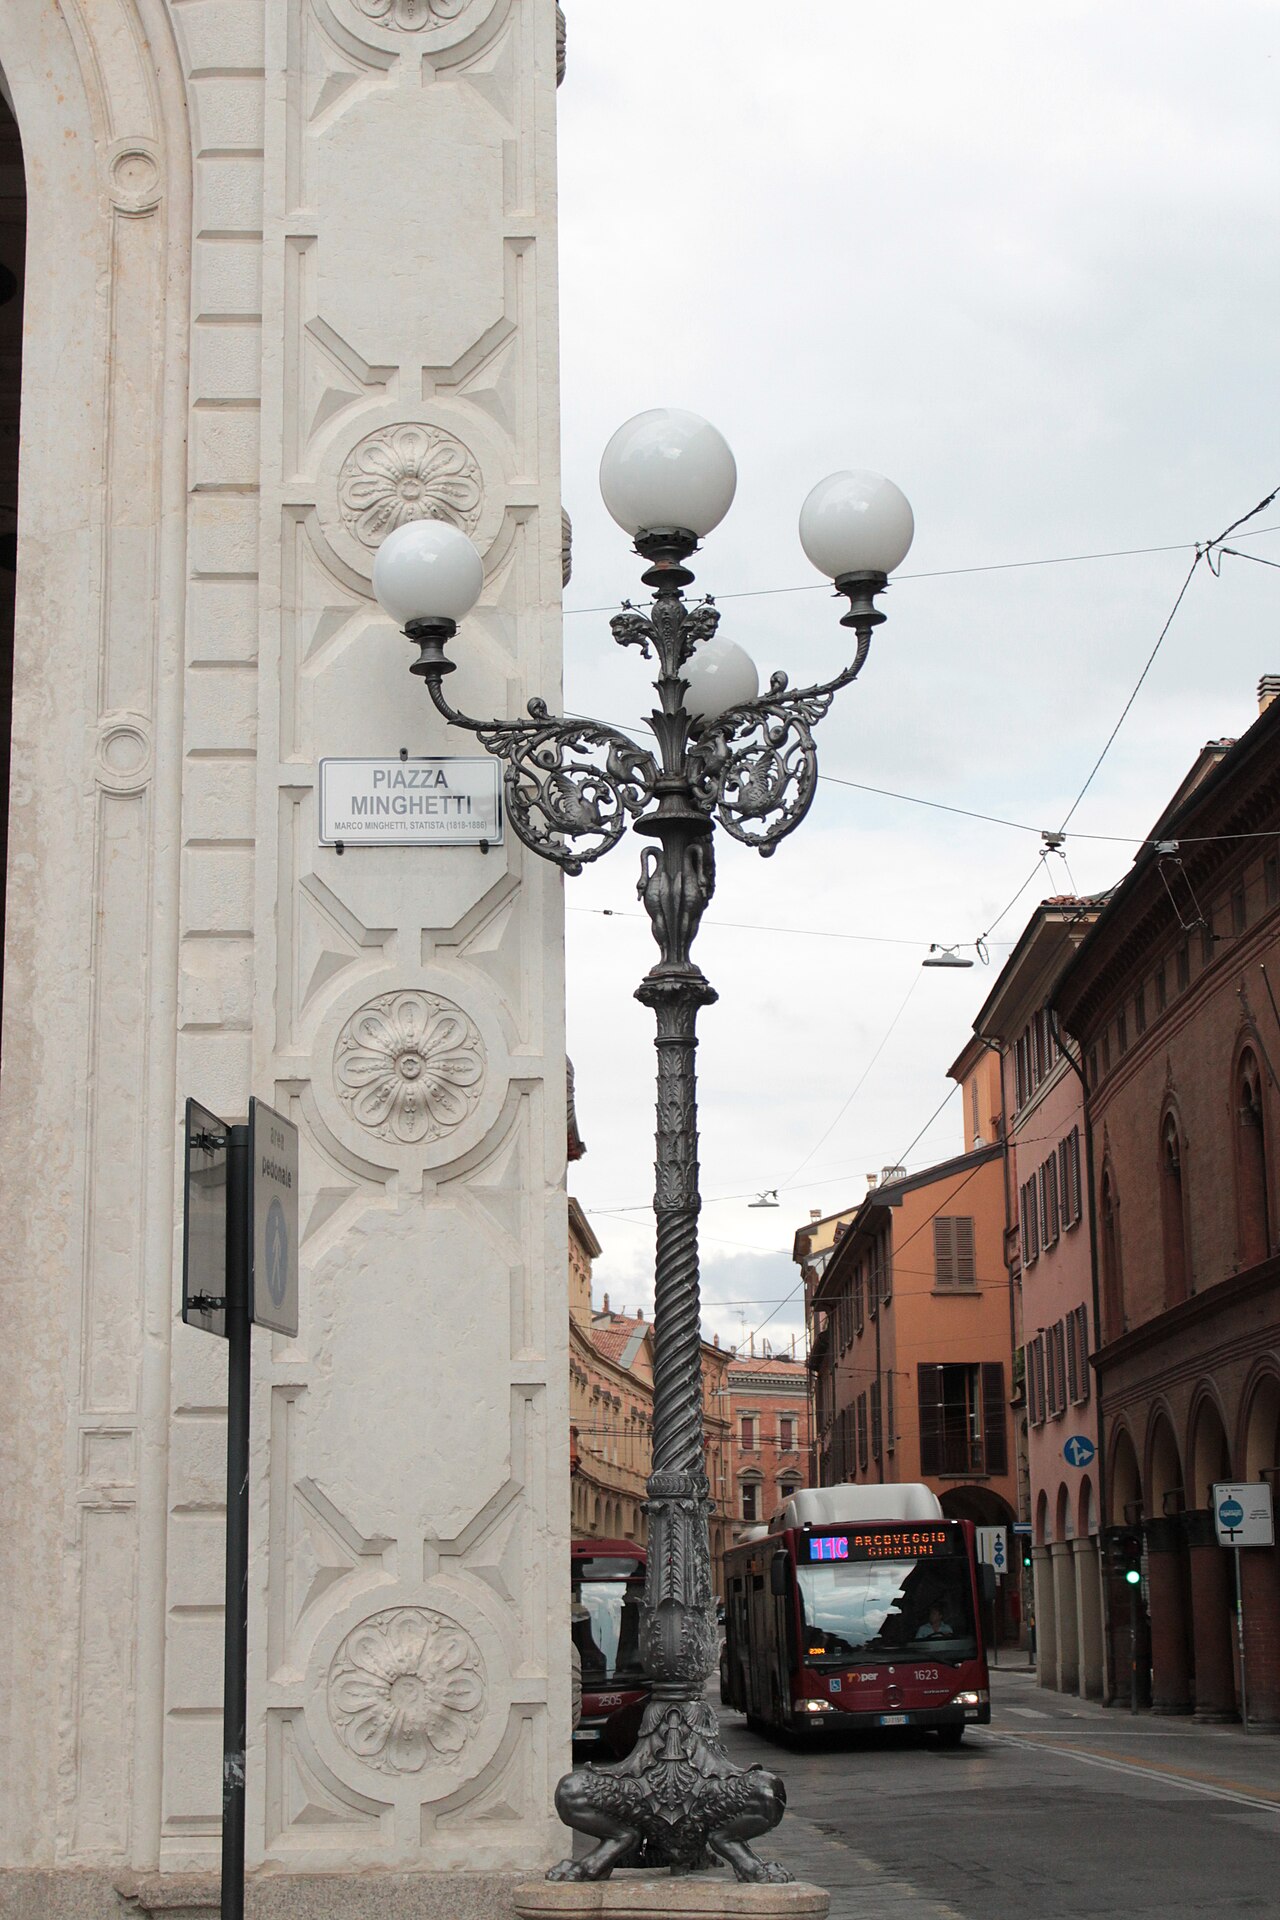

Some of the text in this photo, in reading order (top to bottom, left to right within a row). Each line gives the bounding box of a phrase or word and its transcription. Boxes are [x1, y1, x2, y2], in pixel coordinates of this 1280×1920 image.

[373, 769, 449, 789] PIAZZA
[351, 795, 471, 815] MINGHETTI
[334, 821, 363, 830] MARCO
[364, 821, 408, 831] MINGHETTI,
[410, 821, 445, 830] STATISTA
[812, 1532, 946, 1560] 11C ARCOVEGGIO
[914, 1669, 939, 1681] 1623
[598, 1694, 622, 1707] 2505
